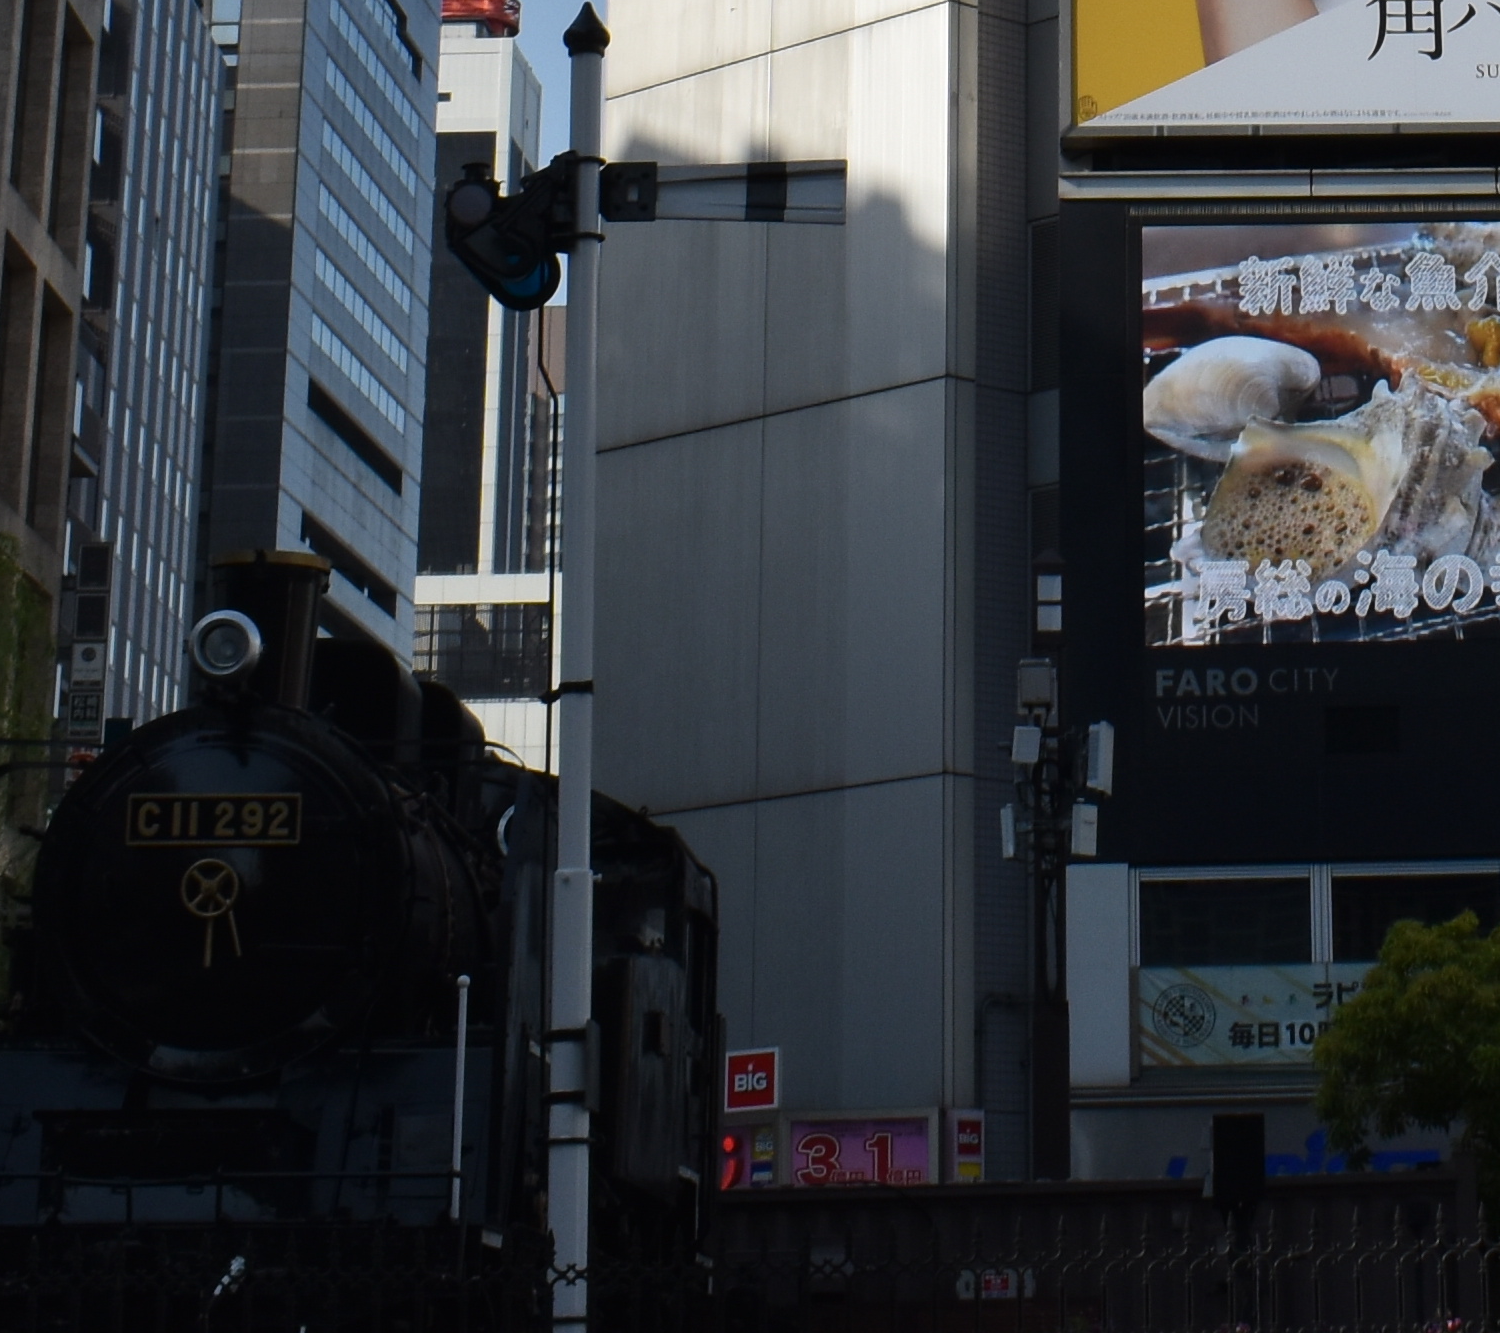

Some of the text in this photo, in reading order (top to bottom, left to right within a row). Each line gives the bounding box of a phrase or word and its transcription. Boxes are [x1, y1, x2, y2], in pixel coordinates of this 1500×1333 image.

[1155, 667, 1340, 697] FARO CITY
[1156, 703, 1259, 730] VISION
[212, 797, 292, 840] 292
[734, 1063, 768, 1093] BIG
